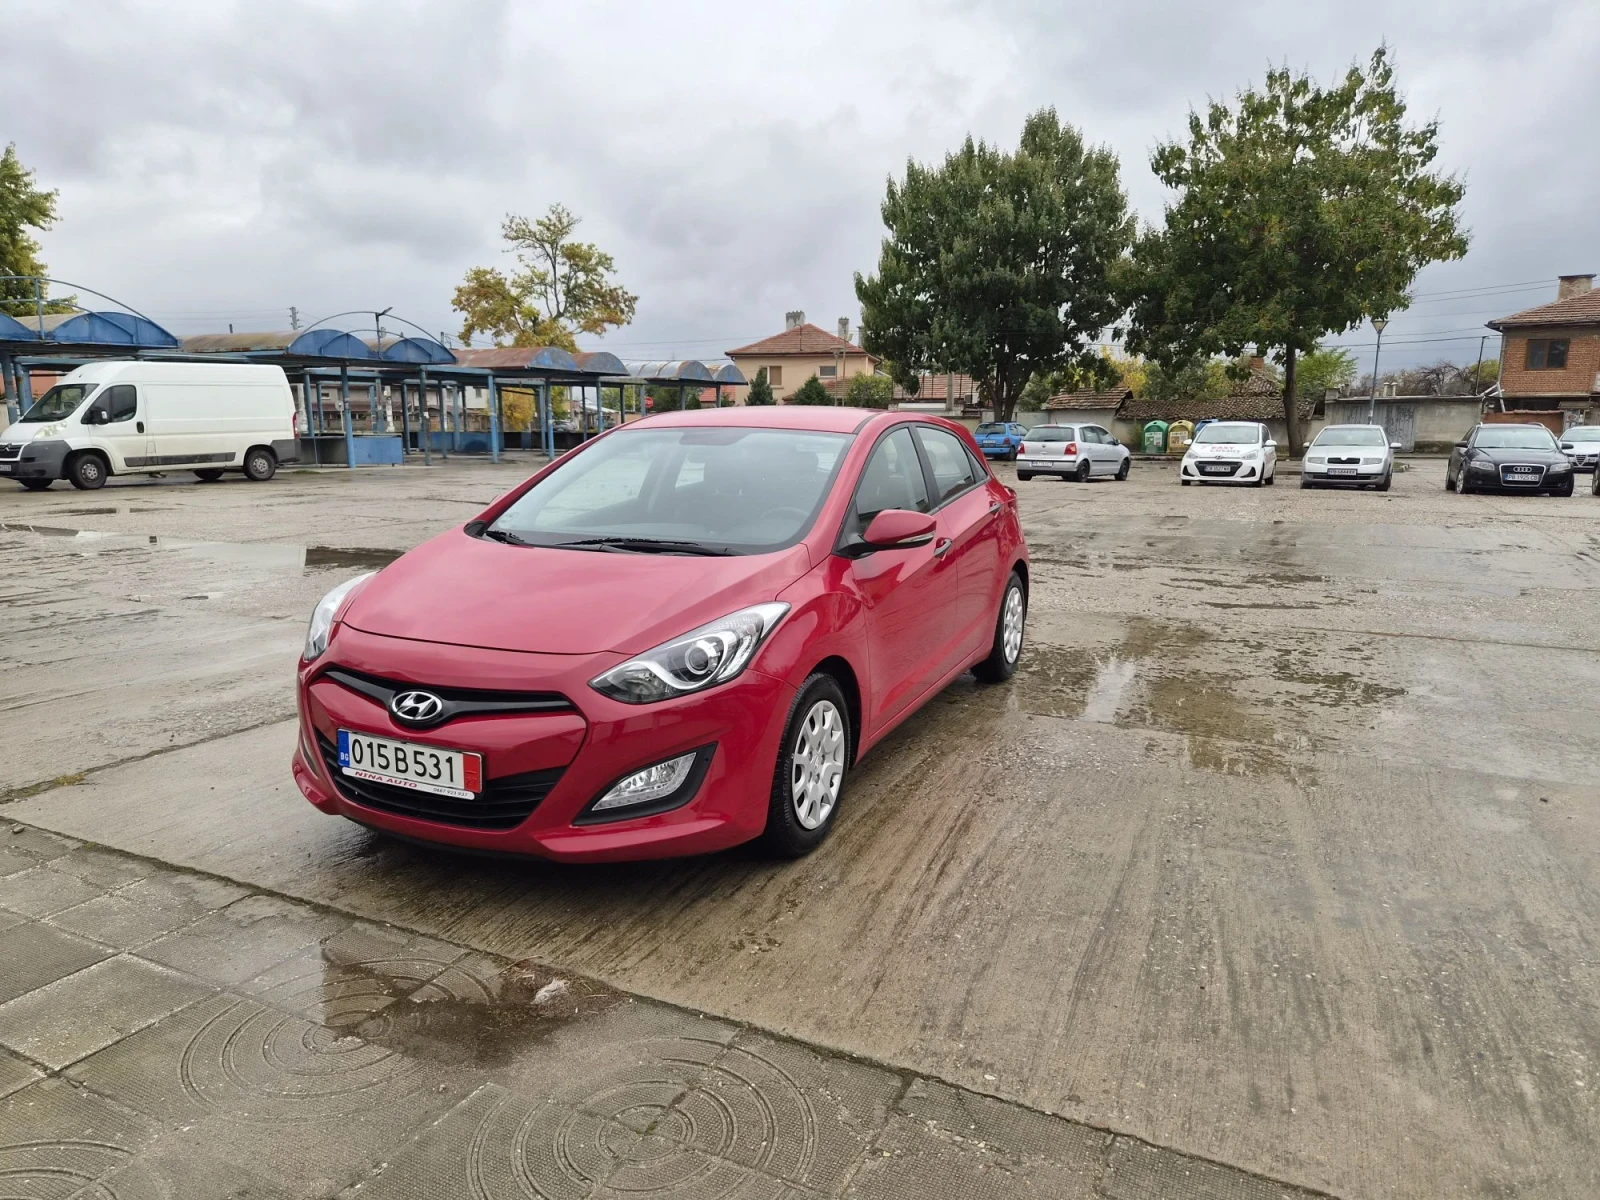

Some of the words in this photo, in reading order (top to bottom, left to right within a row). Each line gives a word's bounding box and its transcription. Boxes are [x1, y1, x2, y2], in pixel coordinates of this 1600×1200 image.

[340, 752, 349, 762] BG
[351, 738, 454, 783] 015B531
[354, 771, 383, 781] NINA
[386, 778, 418, 788] AUTO
